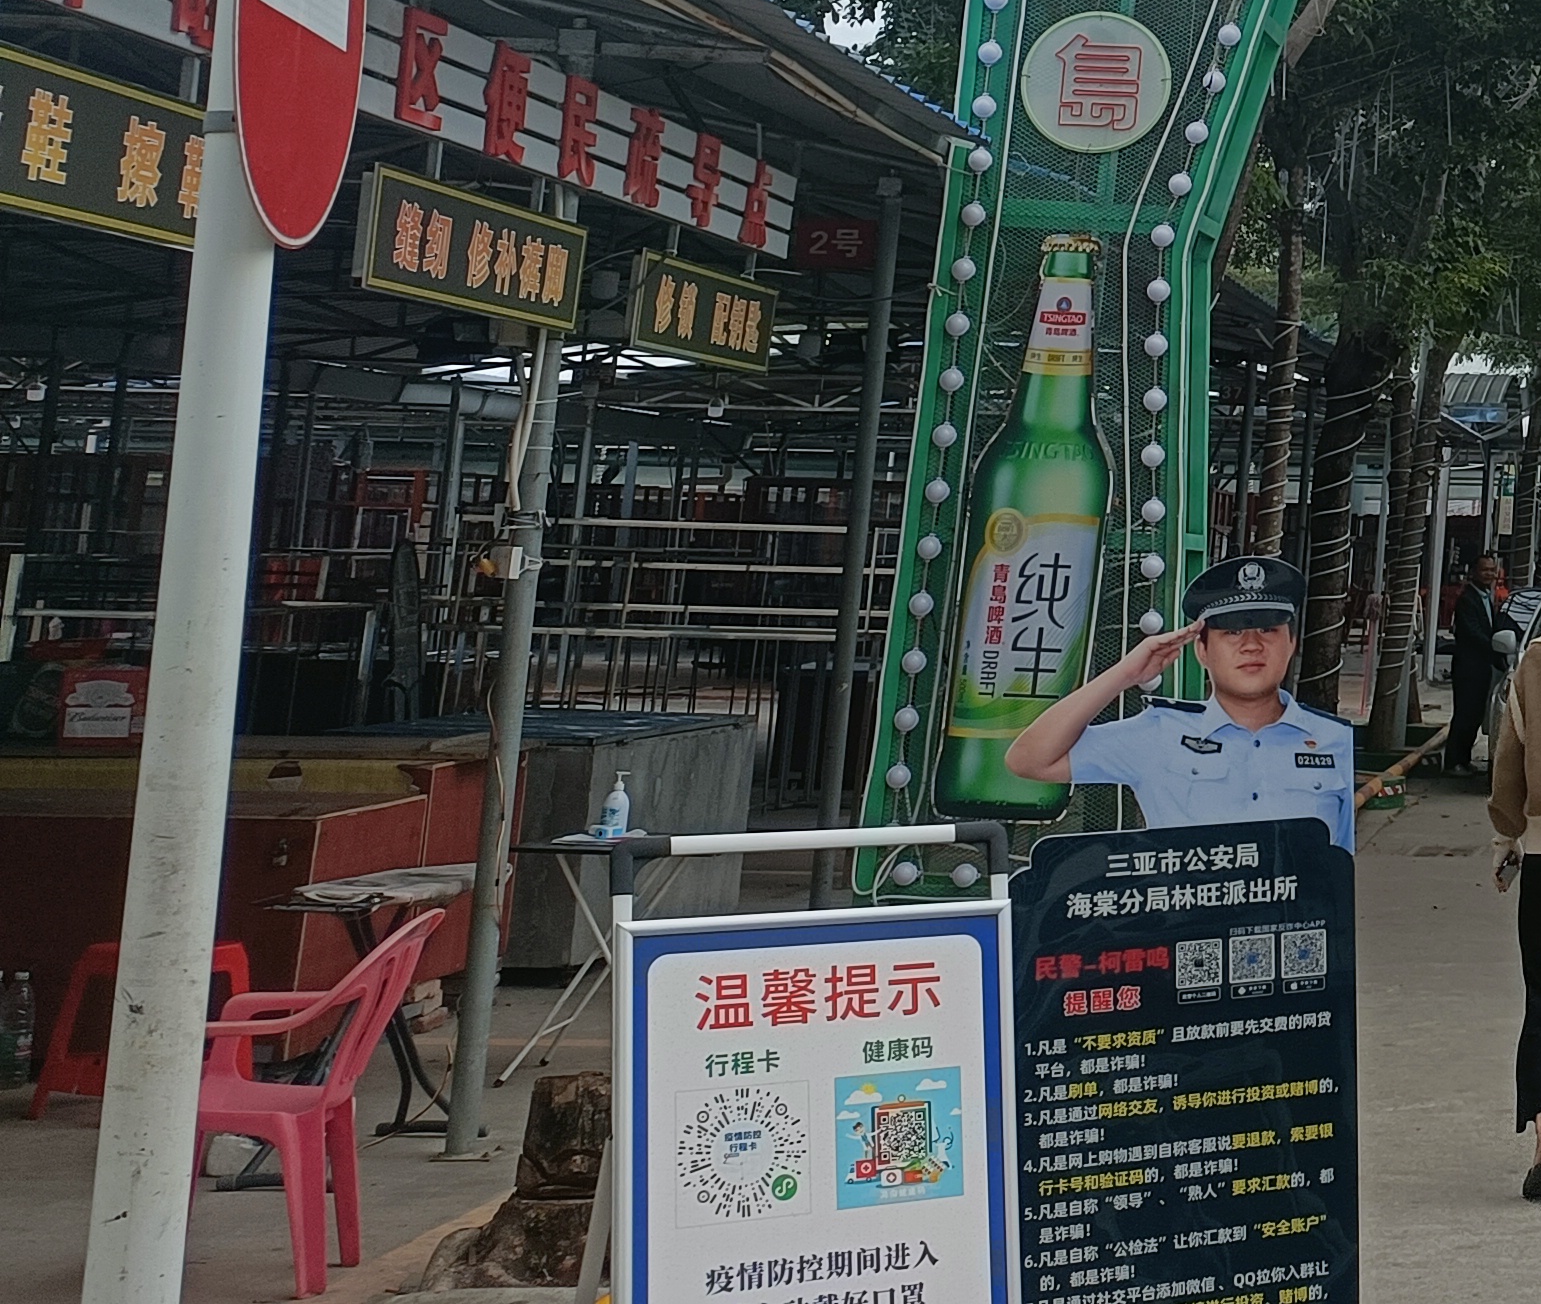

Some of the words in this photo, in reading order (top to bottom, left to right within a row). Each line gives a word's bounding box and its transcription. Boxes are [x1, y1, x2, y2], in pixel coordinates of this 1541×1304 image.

[393, 199, 453, 280] 缝纫
[466, 219, 569, 307] 修补裤脚
[809, 227, 864, 259] 2号
[654, 274, 699, 341] 修锁
[710, 291, 762, 354] 配钥匙
[1043, 313, 1084, 324] TSINGTAO
[1003, 552, 1072, 700] 纯生
[978, 650, 1000, 699] DRAFT
[1106, 843, 1259, 877] 三亚市公安局
[1066, 876, 1298, 919] 海棠分局林旺派出所
[695, 962, 941, 1031] 温馨提示
[1064, 986, 1141, 1016] 提醒您
[705, 1049, 781, 1078] 行程卡
[862, 1036, 933, 1063] 健康码
[706, 1240, 939, 1295] 疫情防控期间进入
